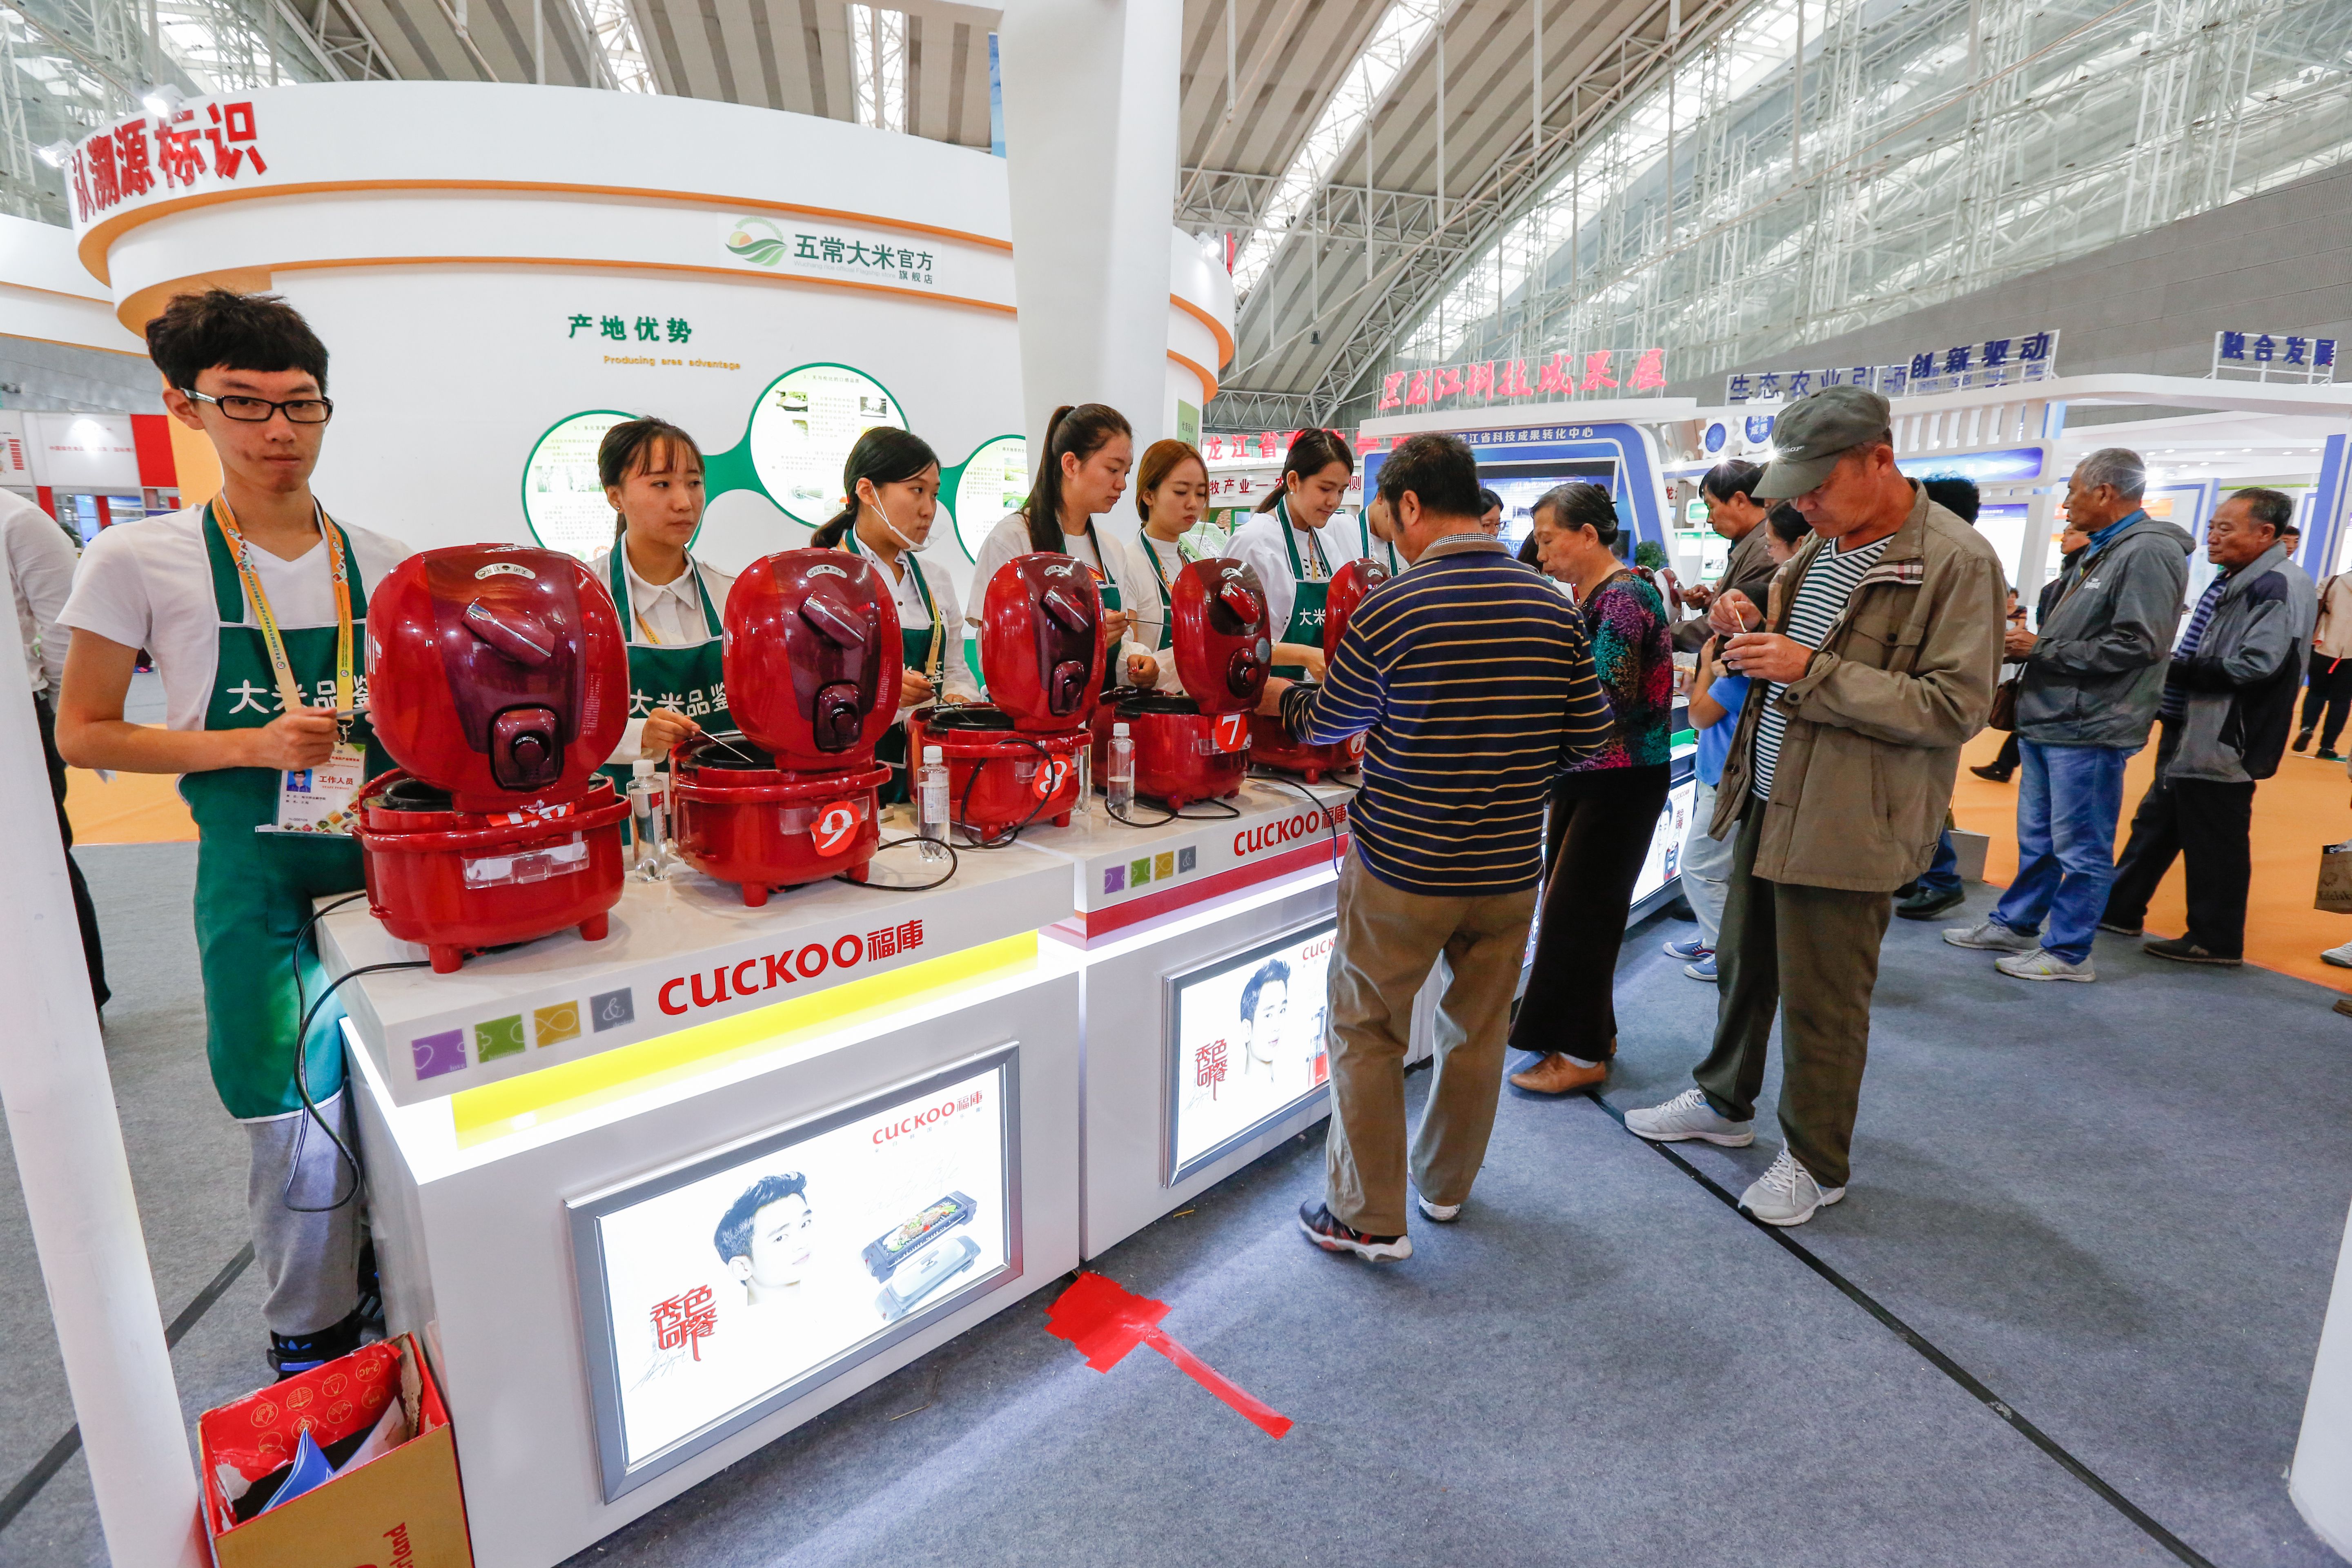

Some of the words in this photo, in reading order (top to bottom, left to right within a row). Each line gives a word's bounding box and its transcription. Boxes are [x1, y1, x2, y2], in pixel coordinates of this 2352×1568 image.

[794, 261, 822, 270] Wuchang
[856, 268, 880, 277] Flagship
[899, 270, 933, 284] 旗舰店
[568, 314, 692, 344] 产地优势
[604, 354, 656, 366] Producing
[688, 358, 741, 371] advantage
[1911, 332, 2050, 378] 创新驱动
[2221, 331, 2336, 367] 融合发展
[1379, 348, 1667, 410] 黑龙江科技成果展
[1750, 423, 1768, 436] 成果
[1299, 608, 1326, 626] 大米
[1223, 715, 1241, 745] 7
[319, 776, 353, 785] 工作人员
[1039, 760, 1068, 795] 8
[820, 809, 853, 849] 9
[1234, 811, 1320, 857] CUCKOO
[658, 934, 863, 1016] CUCKOO
[866, 919, 924, 962] 福庫
[450, 1063, 465, 1071] love
[873, 1102, 955, 1145] CUCKOO
[957, 1090, 982, 1112] 福庫
[382, 1521, 413, 1568] rland
